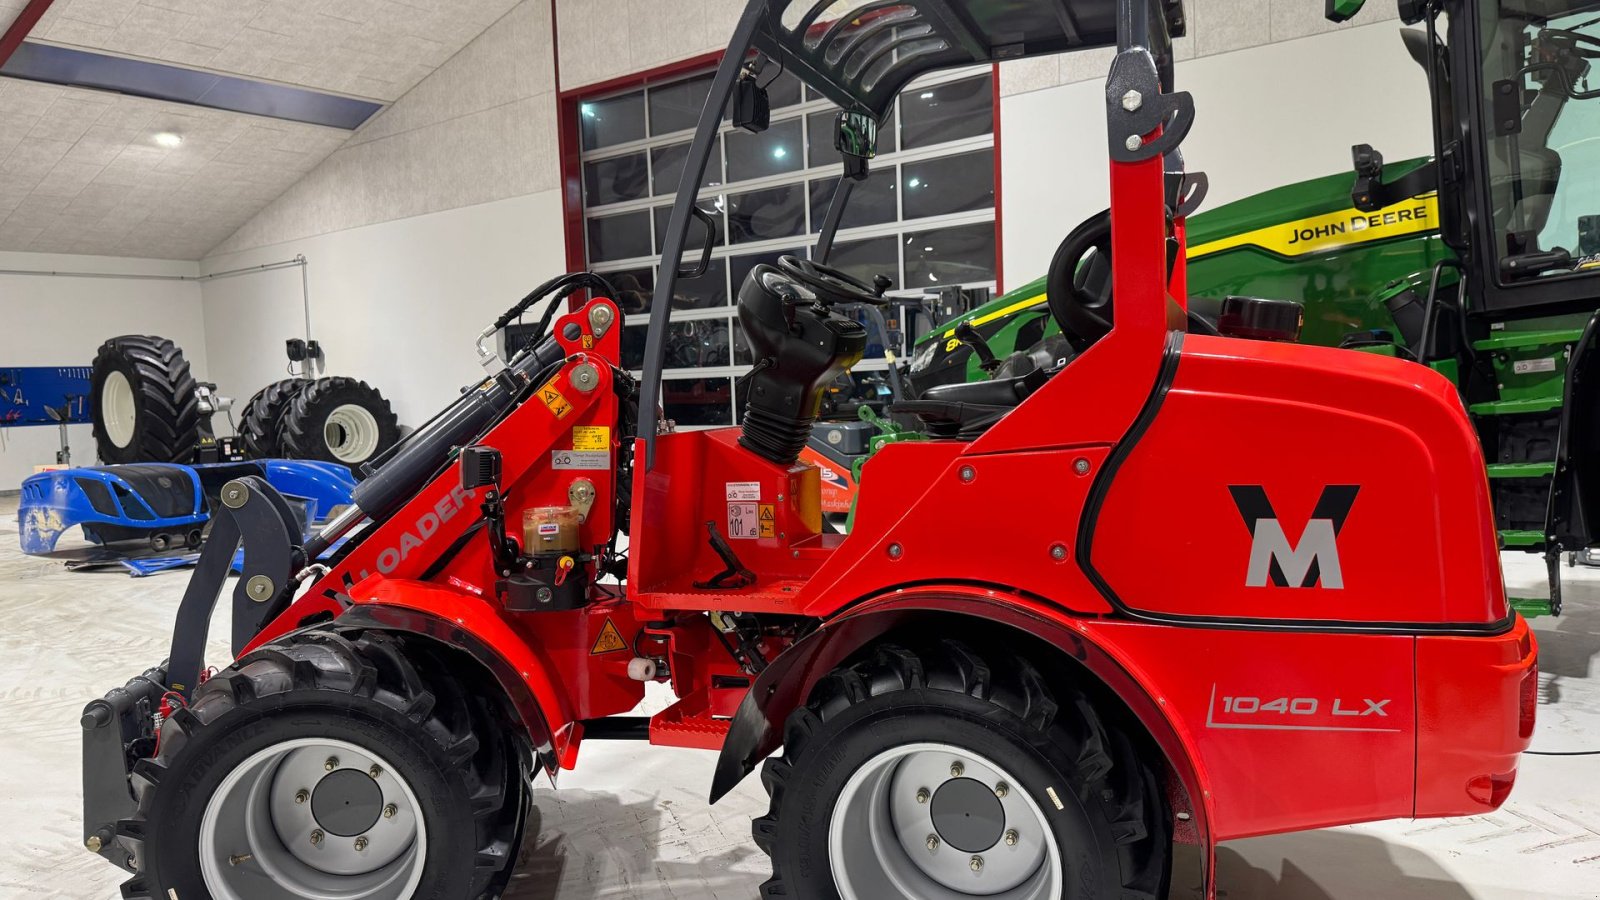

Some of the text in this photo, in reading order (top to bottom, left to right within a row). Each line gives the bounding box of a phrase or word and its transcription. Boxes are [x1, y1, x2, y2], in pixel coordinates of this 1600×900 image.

[1288, 206, 1428, 244] JOHN DEERE
[360, 484, 477, 579] OADER
[730, 518, 744, 536] 101
[1222, 696, 1392, 717] 1040 LX
